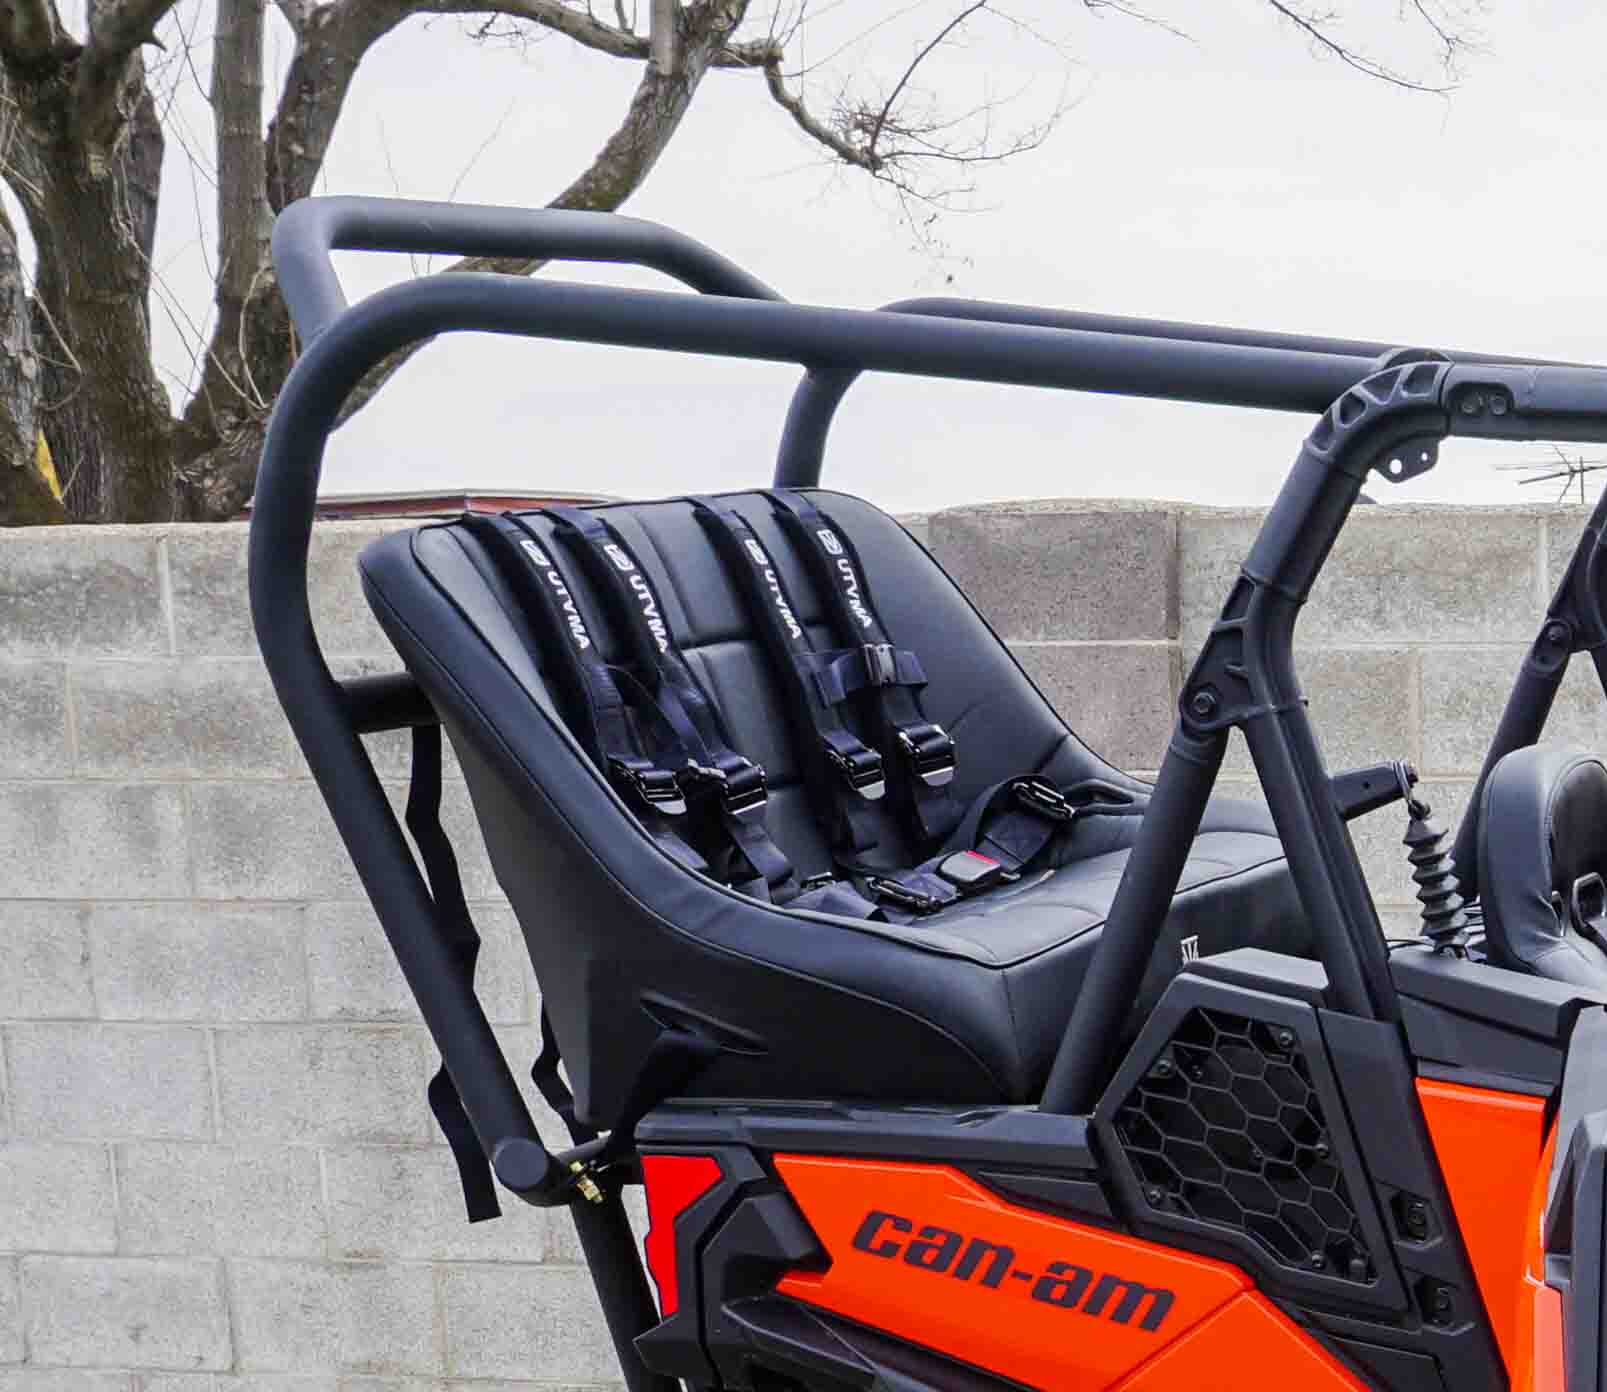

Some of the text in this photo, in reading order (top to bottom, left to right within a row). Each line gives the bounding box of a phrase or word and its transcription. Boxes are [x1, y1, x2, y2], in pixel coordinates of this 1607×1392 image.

[547, 570, 591, 650] UTVMA
[629, 573, 669, 654] UTVMA
[764, 568, 802, 640] UTVMA
[837, 558, 873, 629] UTVMA
[851, 1208, 1176, 1333] can-am
